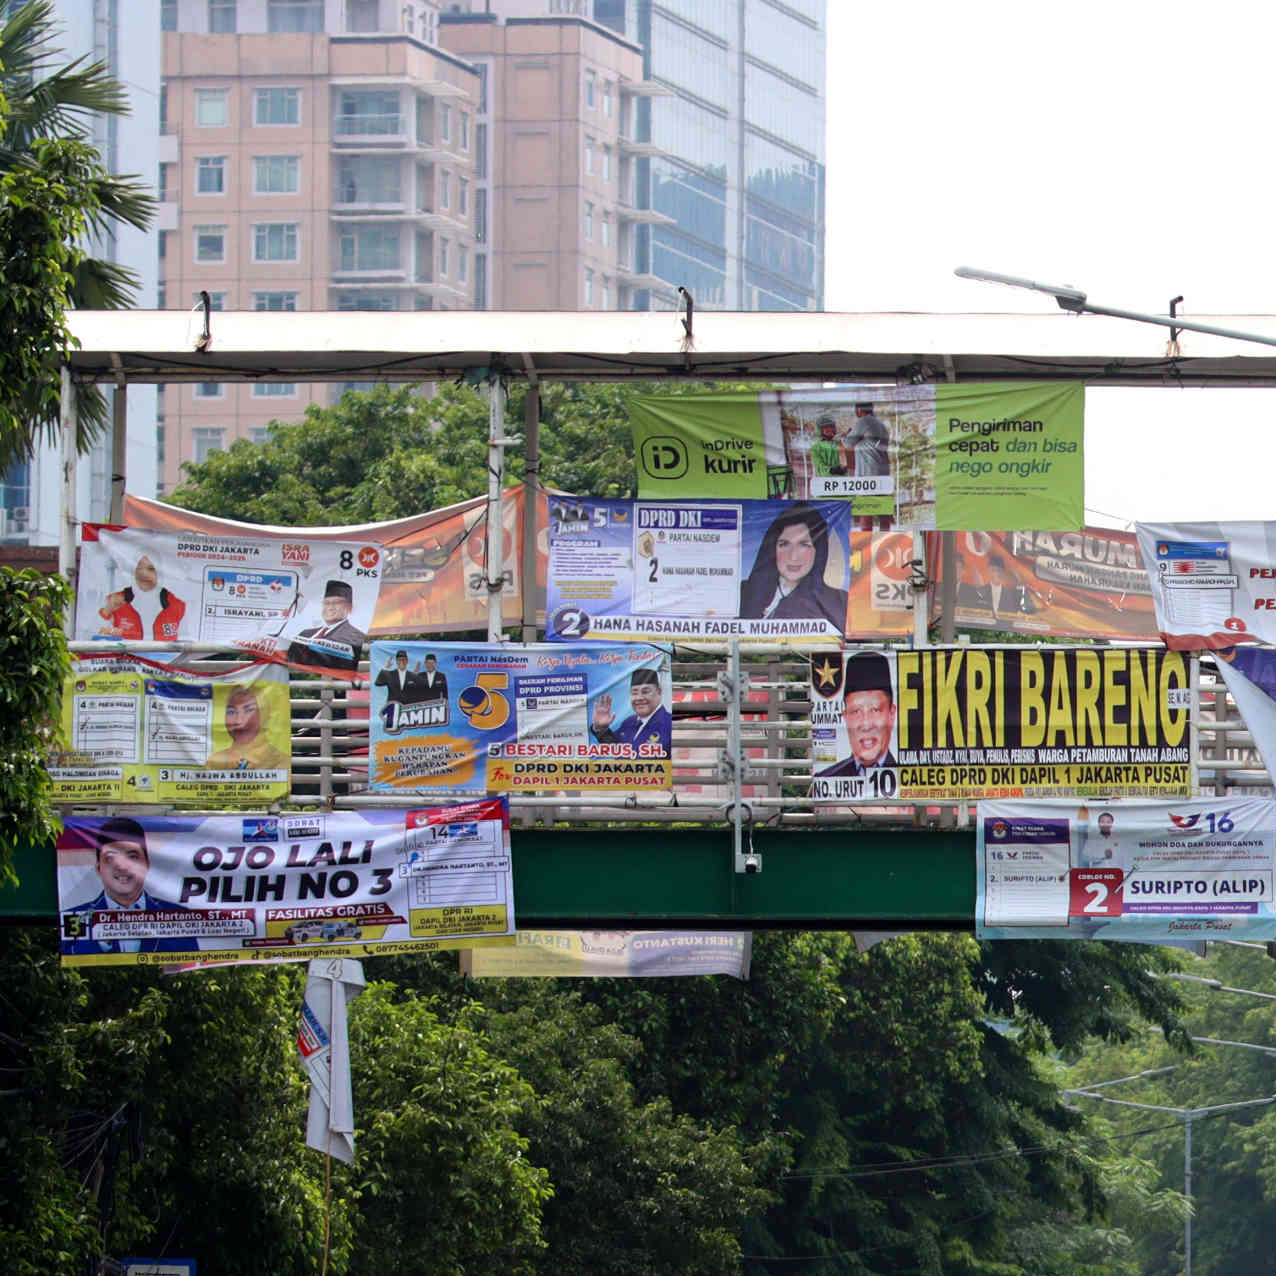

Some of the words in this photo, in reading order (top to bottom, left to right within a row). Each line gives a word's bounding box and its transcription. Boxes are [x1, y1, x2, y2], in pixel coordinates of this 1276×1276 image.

[949, 418, 1043, 436] Pengiriman
[701, 438, 753, 452] inDrive
[948, 440, 999, 457] cepat
[1006, 438, 1038, 453] dan
[1043, 438, 1077, 453] bisa
[704, 454, 757, 474] kurir
[949, 461, 992, 478] nego
[998, 459, 1051, 477] ongkir
[824, 481, 839, 492] RP
[843, 480, 876, 491] 12000
[640, 509, 676, 527] DPRD
[339, 550, 353, 570] 8
[356, 568, 378, 578] PKS
[649, 558, 658, 582] 2
[593, 617, 631, 631] HANA
[636, 619, 700, 633] HASANAH
[705, 621, 745, 634] FADEL
[750, 622, 827, 635] MUHAMMAD
[901, 650, 1005, 749] FIKRI
[811, 713, 843, 724] UMMAT
[506, 743, 573, 757] BESTARI
[577, 743, 636, 759] BARUS,
[640, 744, 668, 757] SH.
[1038, 749, 1069, 763] WARGA
[1071, 749, 1128, 763] PETAMBURAN
[1130, 749, 1159, 763] TANAH
[1160, 749, 1189, 763] ABANG
[514, 763, 558, 774] DPRD
[562, 763, 589, 774] DKI
[594, 762, 665, 774] JAKARTA
[901, 768, 946, 786] CALEG
[950, 768, 987, 785] DPRD
[991, 768, 1016, 785] DKI
[1020, 767, 1059, 785] DAPIL
[1076, 767, 1142, 784] JAKARTA
[1143, 766, 1188, 783] PUSAT
[513, 776, 550, 786] DAPIL
[563, 776, 622, 786] JAKARTA
[624, 776, 666, 786] PUSAT
[813, 782, 832, 798] NO.
[835, 780, 864, 797] URUT
[869, 772, 897, 797] 10
[1205, 813, 1234, 833] 16
[193, 845, 277, 871] OJO
[286, 840, 376, 868] LALI
[180, 872, 291, 903] PILIH
[299, 869, 358, 899] NO
[370, 868, 394, 895] 3
[1131, 880, 1208, 895] SURIPTO
[1212, 880, 1265, 897] (ALIP)
[1084, 882, 1109, 913] 2
[267, 907, 334, 920] FASILITAS
[336, 903, 386, 916] GRATIS
